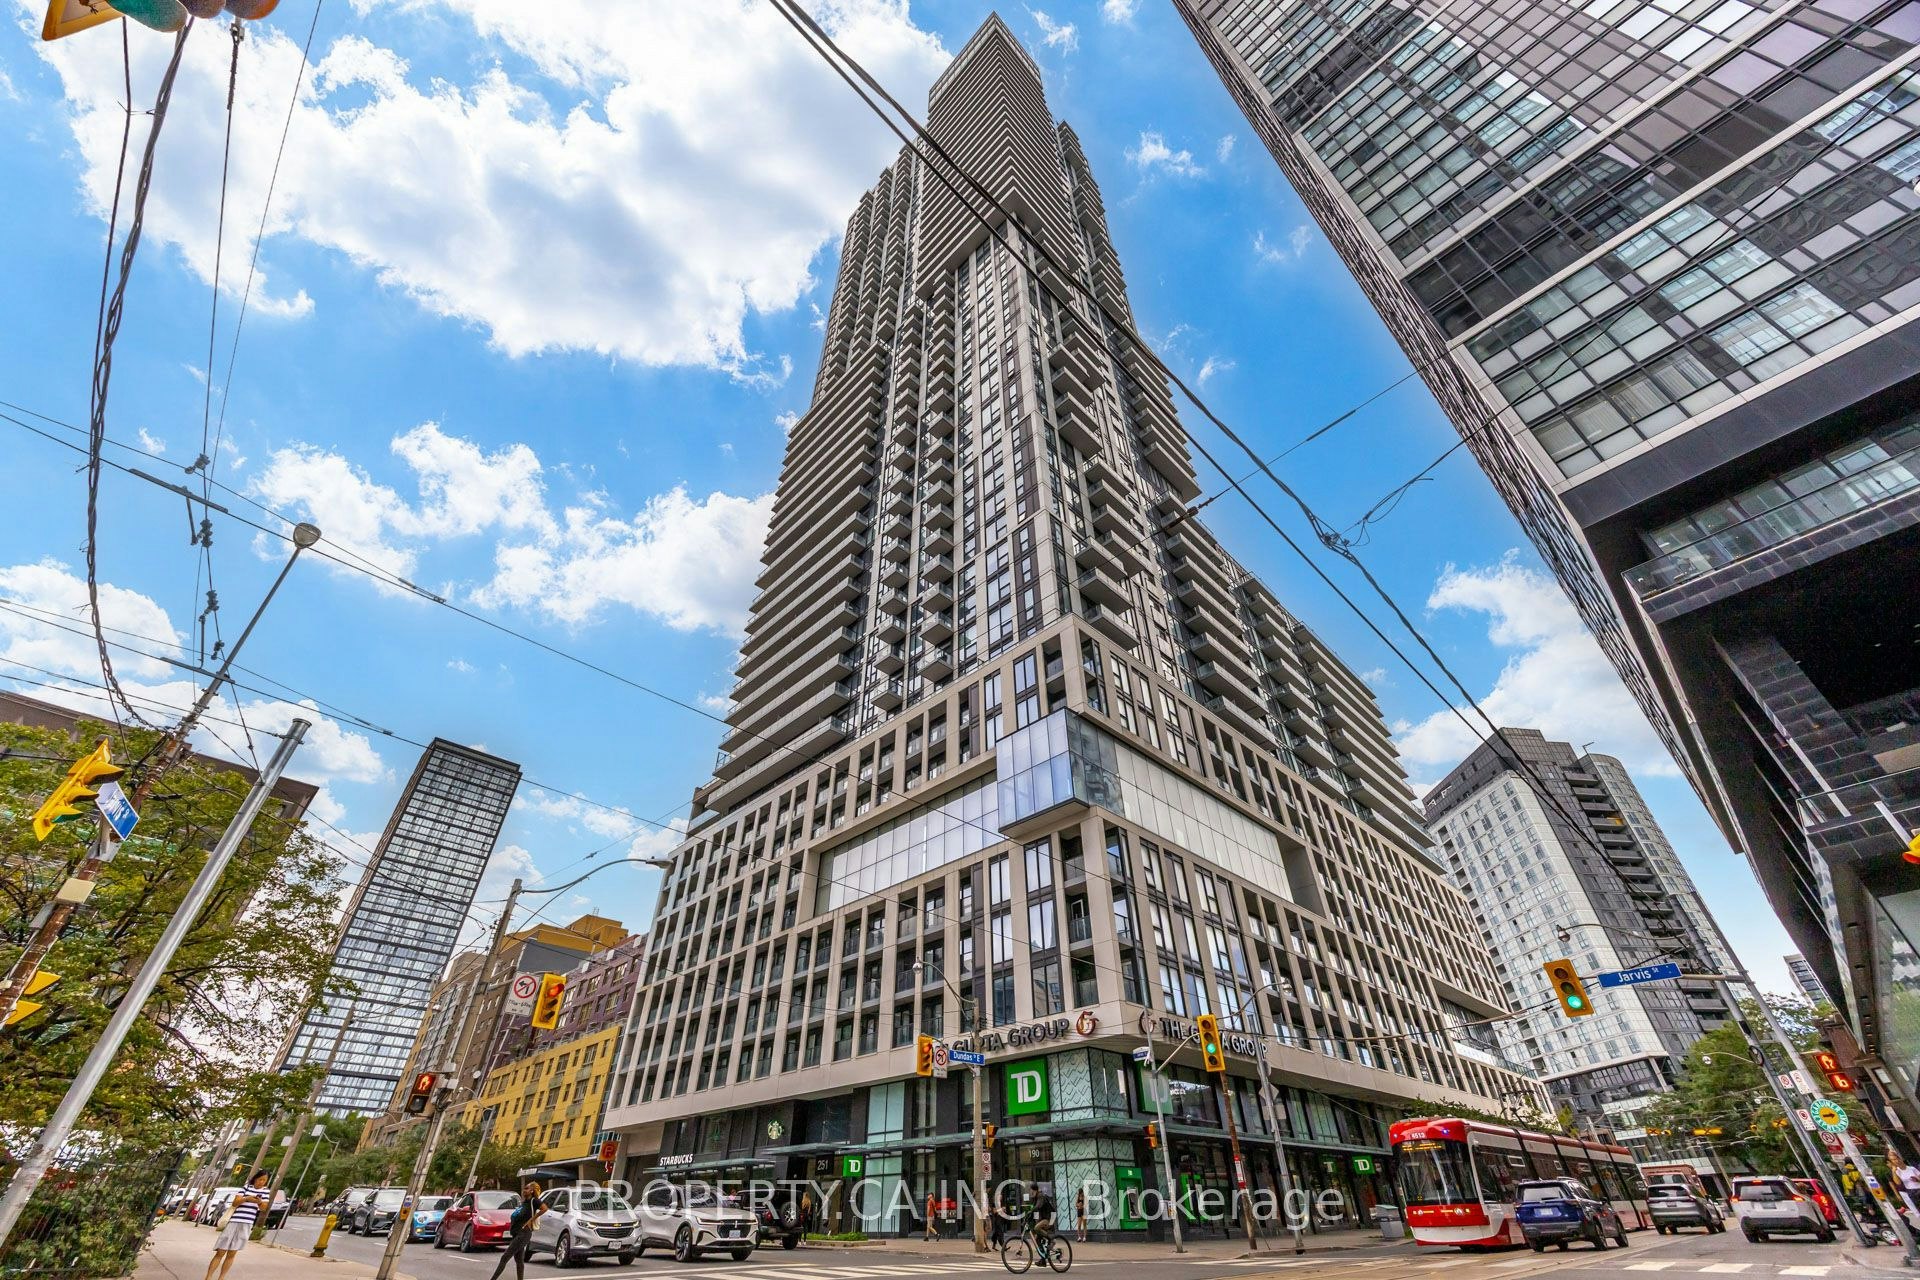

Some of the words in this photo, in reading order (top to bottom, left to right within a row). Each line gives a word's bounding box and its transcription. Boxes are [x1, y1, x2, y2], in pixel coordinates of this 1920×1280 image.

[1617, 969, 1652, 983] Jarvis
[1007, 1018, 1069, 1046] GROUP
[1160, 1018, 1186, 1040] THE
[953, 1052, 973, 1061] Dundas
[1010, 1070, 1042, 1103] TD
[659, 1153, 694, 1167] STARBUCKS
[1028, 1149, 1041, 1158] 190
[817, 1159, 829, 1171] 251
[848, 1159, 861, 1173] TD
[1354, 1159, 1370, 1171] TD
